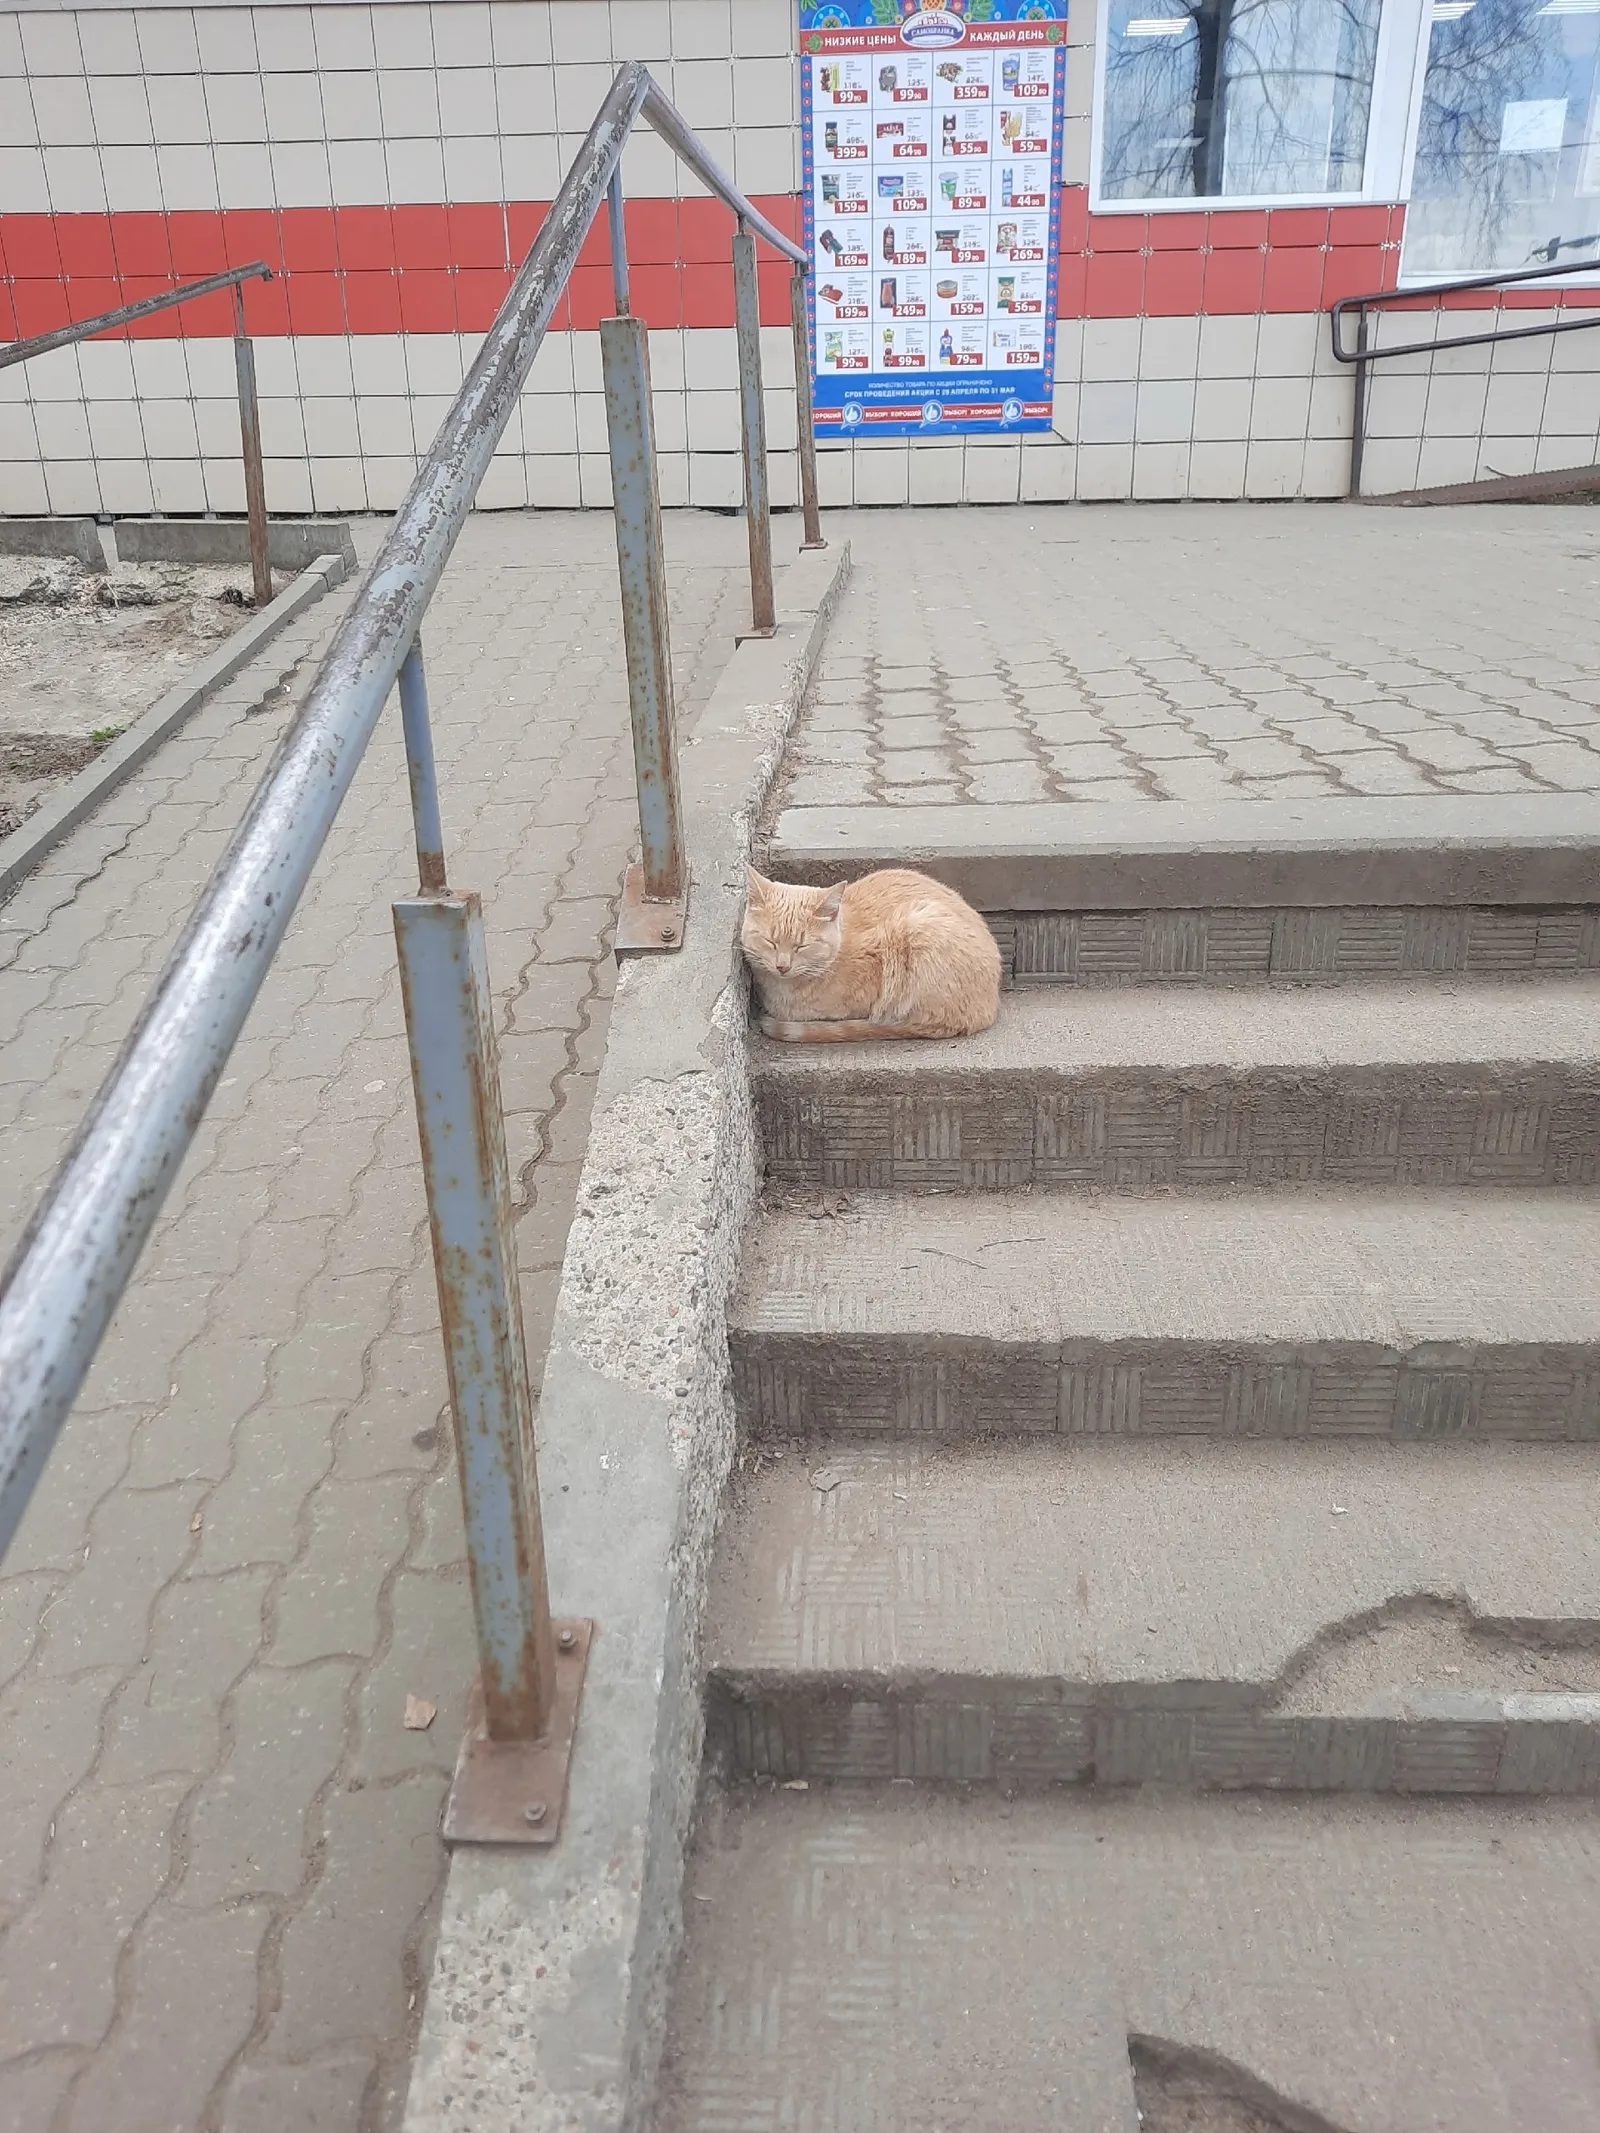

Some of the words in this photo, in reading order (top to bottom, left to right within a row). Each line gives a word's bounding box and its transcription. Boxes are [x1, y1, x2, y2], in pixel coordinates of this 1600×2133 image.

[825, 36, 864, 46] НИЗКИЕ
[867, 35, 896, 46] ЦЕНЫ
[970, 29, 1015, 43] КАЖДЫЙ
[1017, 30, 1044, 41] ДЕНЬ
